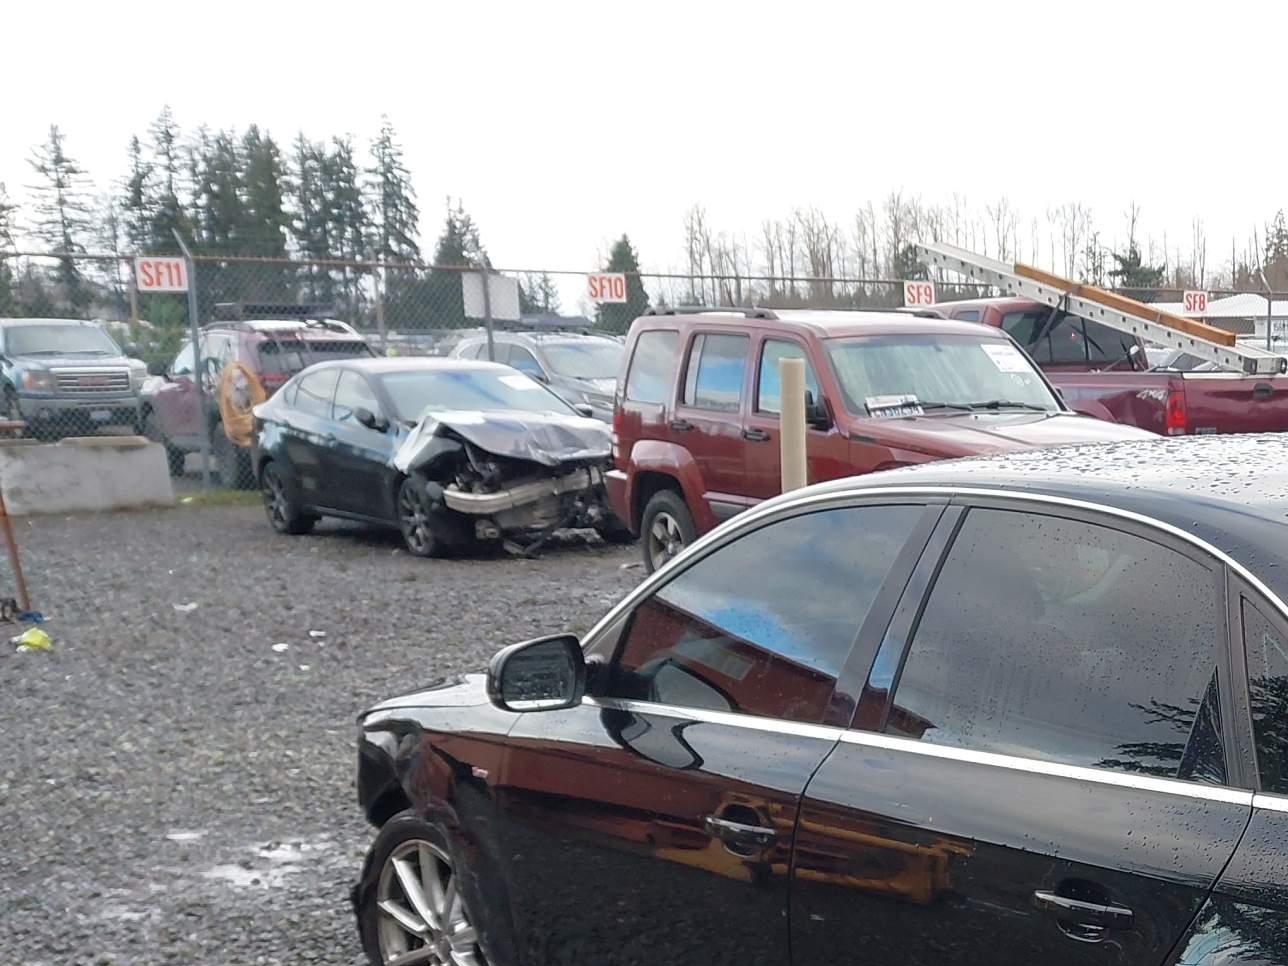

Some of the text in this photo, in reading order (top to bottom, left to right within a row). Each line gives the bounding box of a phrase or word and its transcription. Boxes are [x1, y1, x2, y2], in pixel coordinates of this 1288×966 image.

[140, 261, 183, 287] SF11
[588, 275, 625, 298] SF10
[906, 283, 933, 305] SF9
[1185, 292, 1206, 312] SF8
